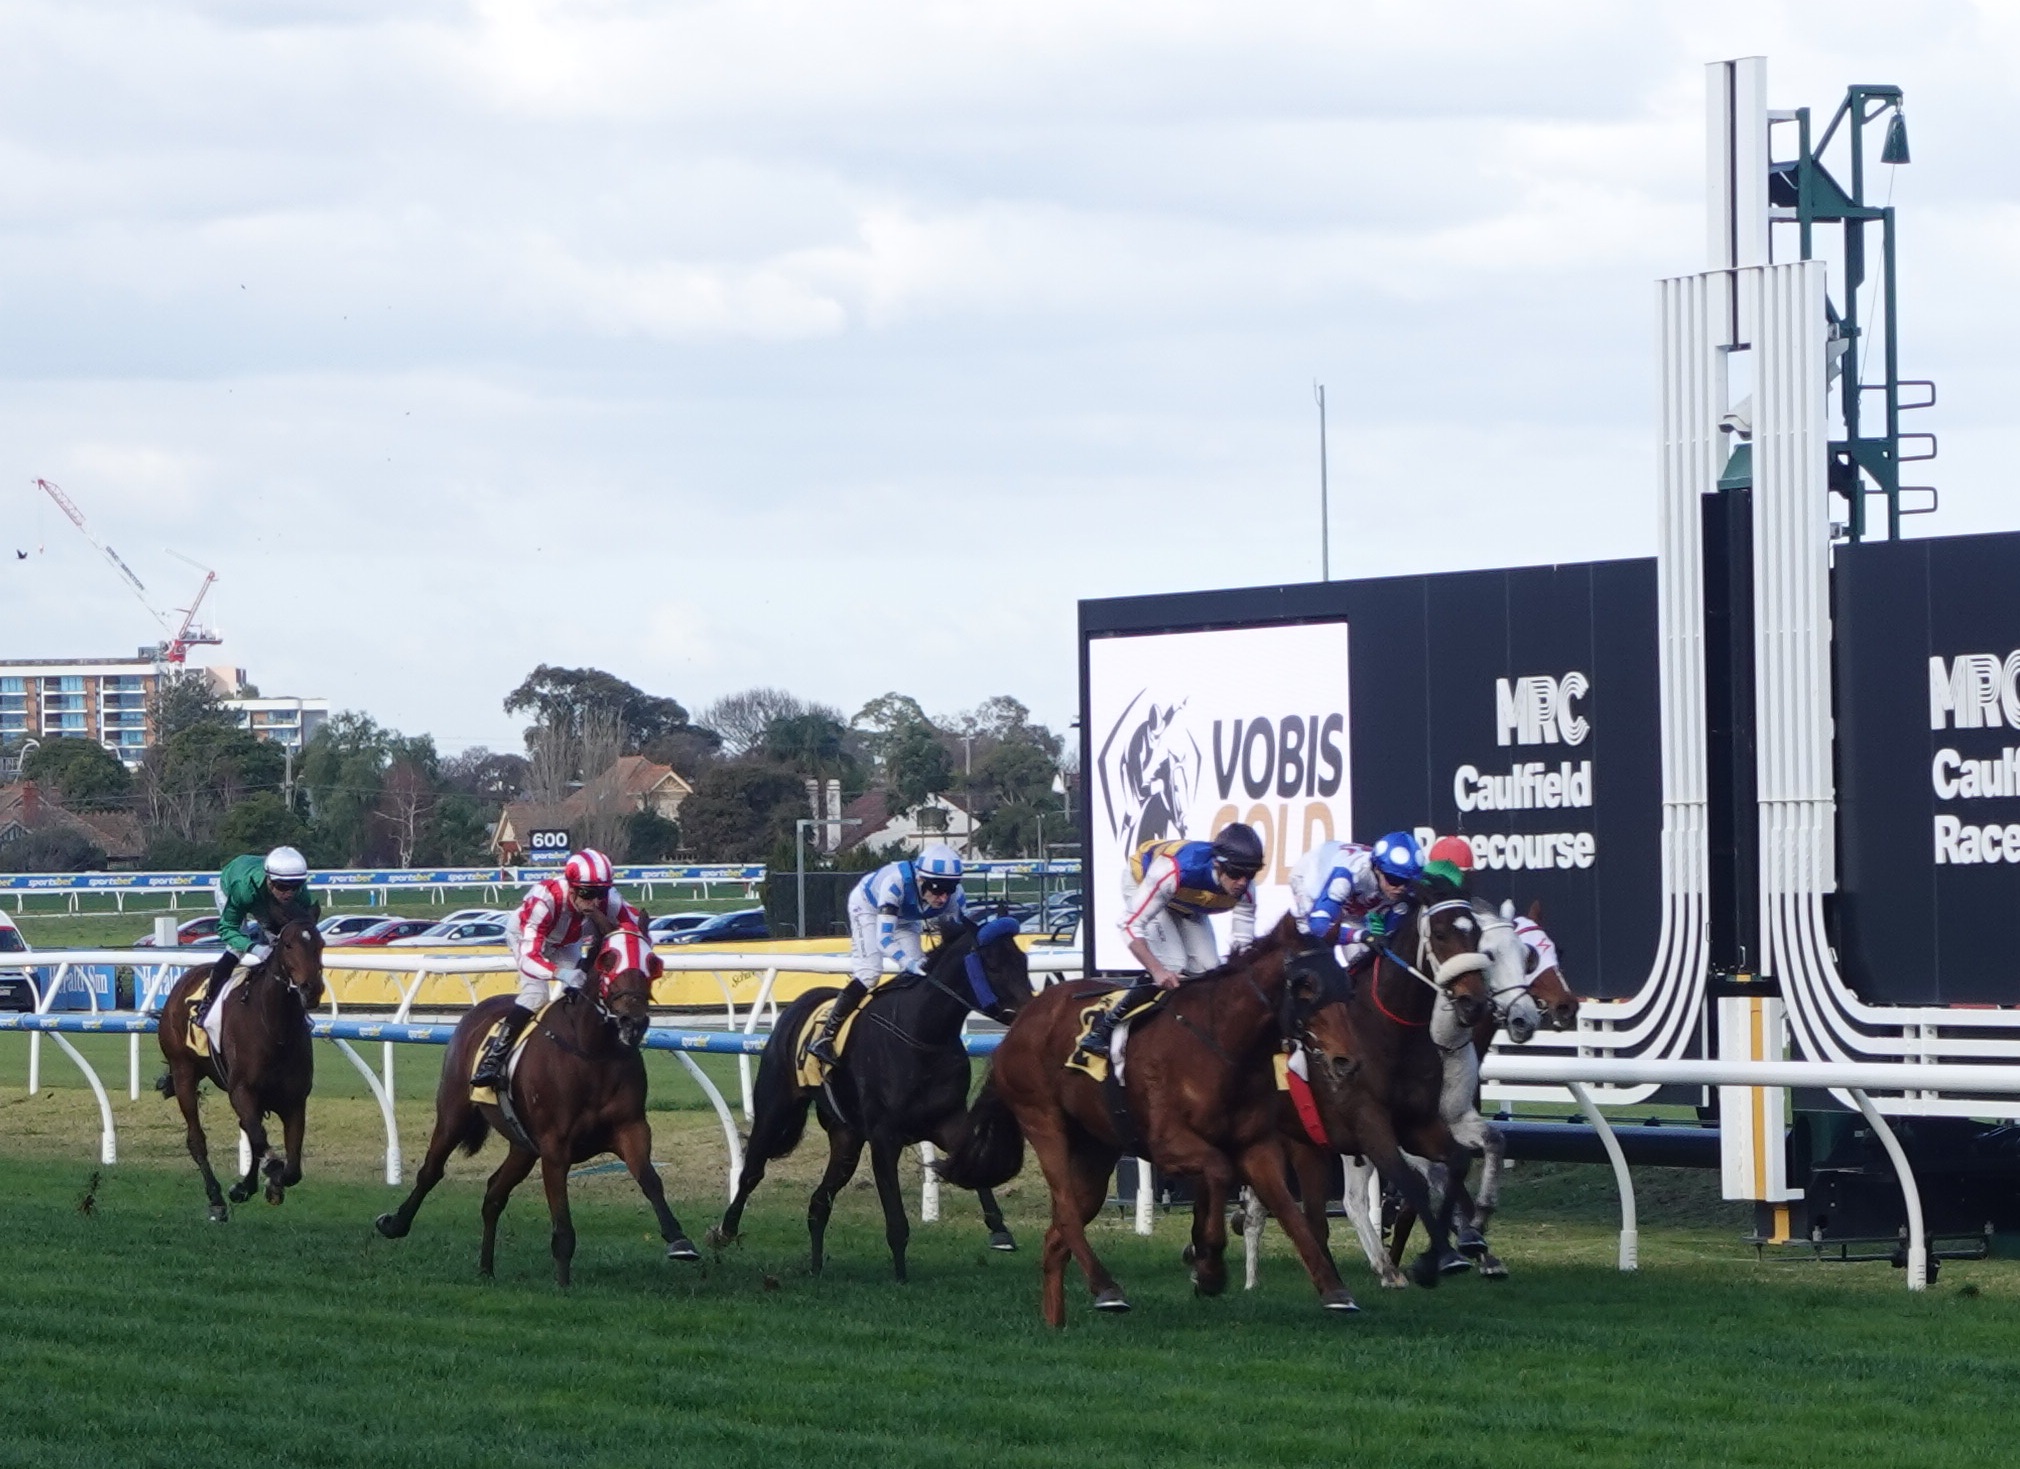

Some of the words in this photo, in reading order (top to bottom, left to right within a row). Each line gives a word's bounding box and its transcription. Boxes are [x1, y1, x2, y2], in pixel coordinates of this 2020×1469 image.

[1496, 672, 1590, 746] MRC
[1213, 713, 1344, 800] VOBIS
[1932, 747, 2020, 800] Caul
[1454, 761, 1592, 812] Caulfield
[532, 832, 567, 848] 600
[1414, 827, 1596, 871] Recourse
